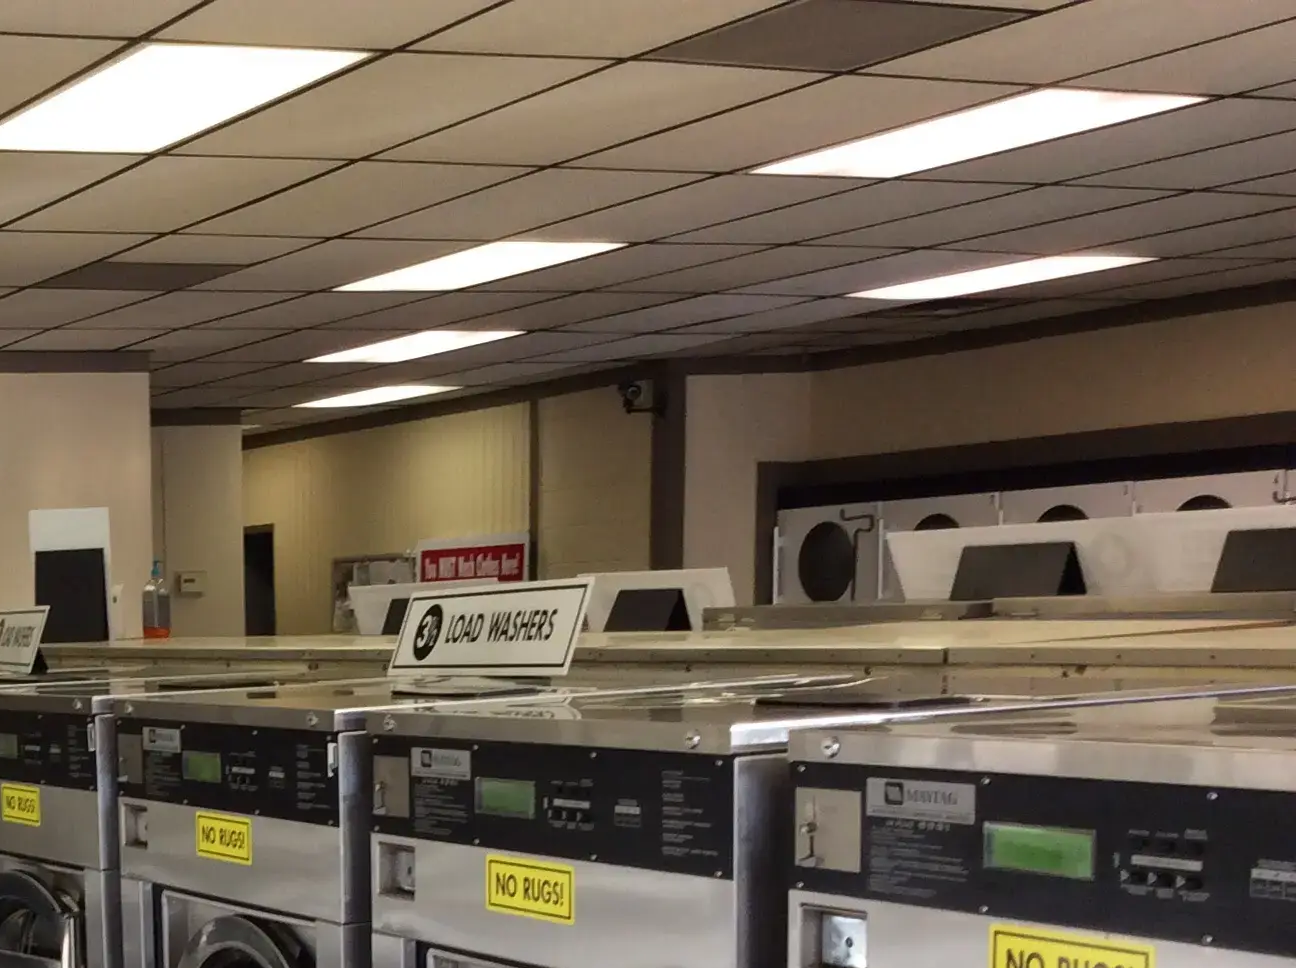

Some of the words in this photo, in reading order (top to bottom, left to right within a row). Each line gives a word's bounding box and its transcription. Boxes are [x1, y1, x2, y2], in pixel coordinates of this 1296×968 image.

[444, 613, 485, 644] LOAD
[487, 608, 558, 643] WASHERS
[201, 825, 216, 845] NO
[496, 871, 517, 898] NO
[523, 876, 564, 907] RUGS!
